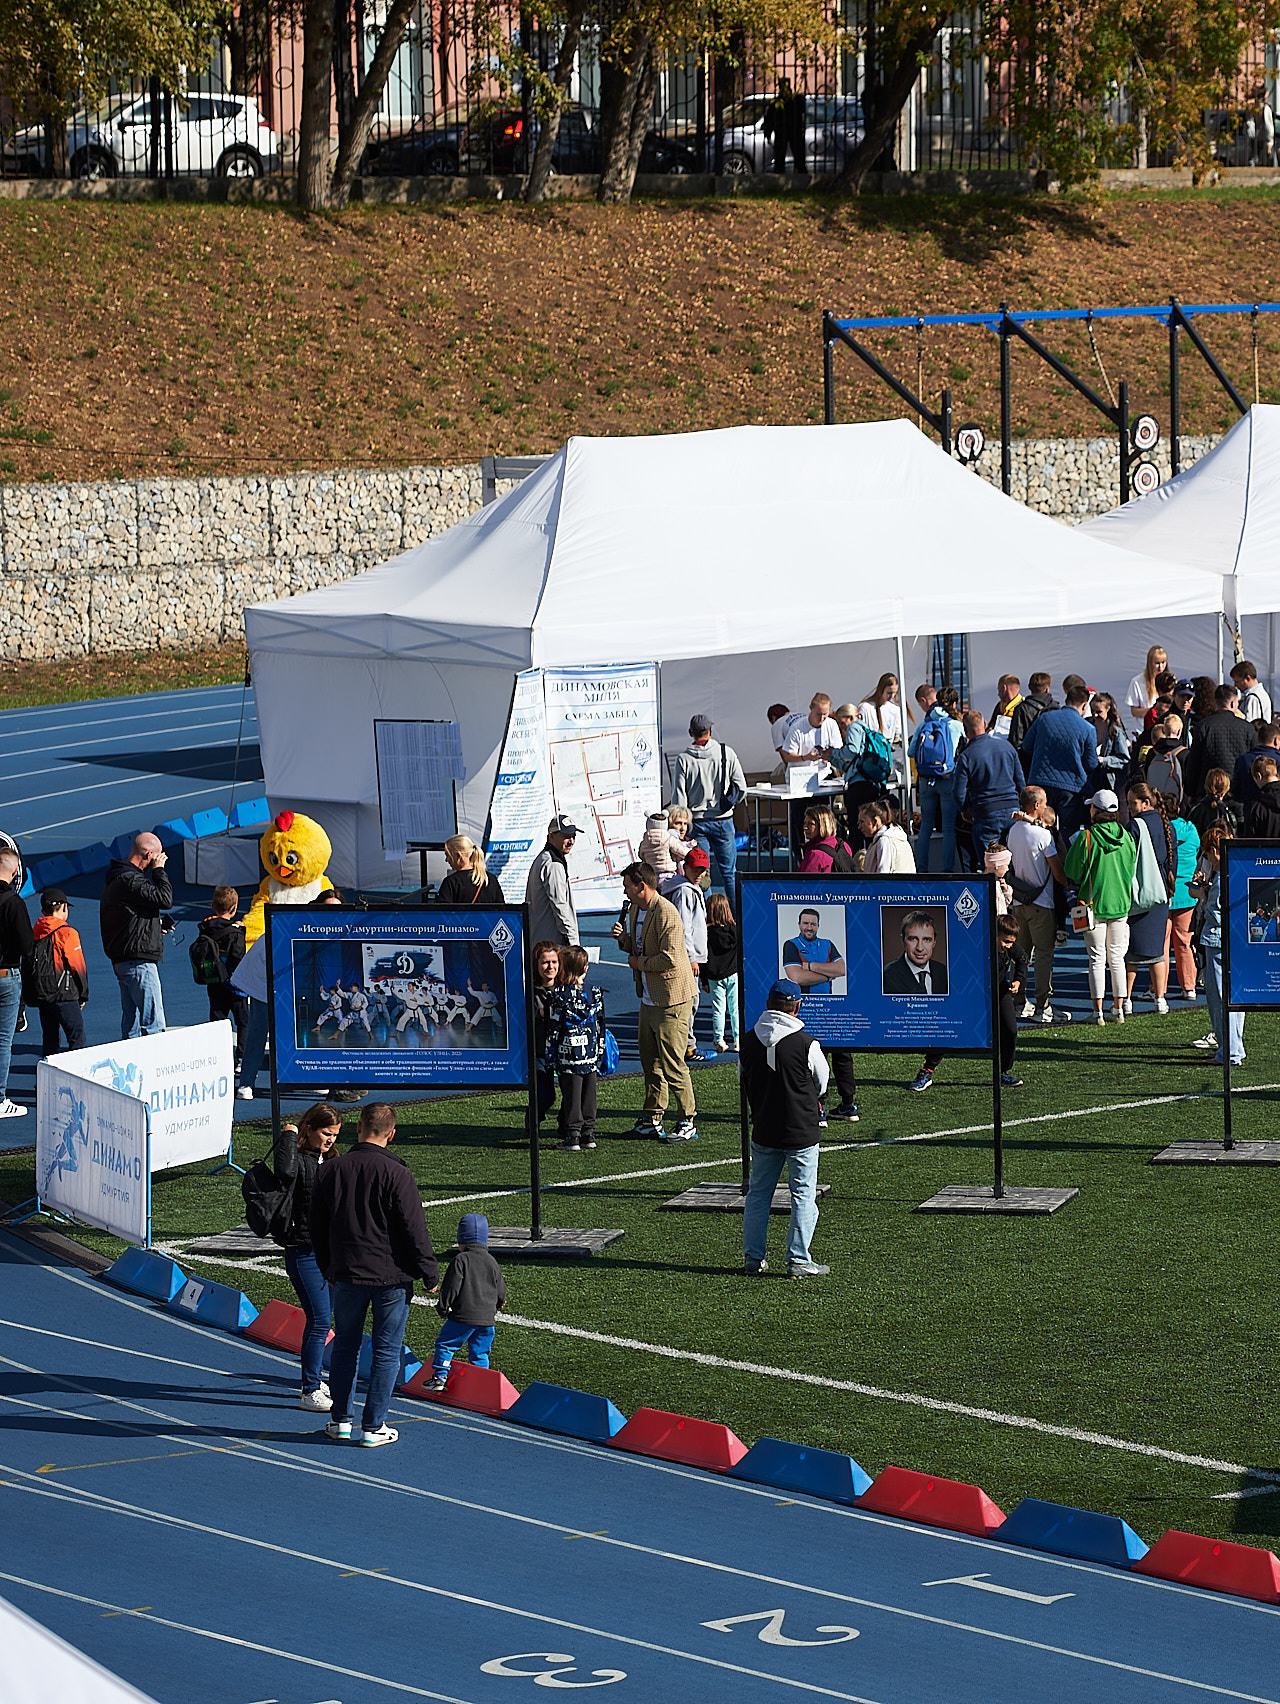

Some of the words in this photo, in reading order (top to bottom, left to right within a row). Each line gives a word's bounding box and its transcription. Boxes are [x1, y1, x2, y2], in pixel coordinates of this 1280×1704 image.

[551, 678, 649, 693] ДИНАМОВСКАЯ
[584, 691, 620, 703] МИЛЯ
[770, 893, 823, 902] Динамовцы
[825, 893, 871, 902] Удмуртии
[878, 893, 916, 902] гордость
[918, 893, 949, 902] страны
[298, 924, 343, 934] «История
[345, 924, 436, 934] Удмуртии-история
[437, 924, 480, 934] Динамо»
[156, 1056, 218, 1078] DYNAMO-UDM.RU
[150, 1076, 228, 1113] ДИНАМО
[165, 1115, 210, 1136] УДМУРТИЯ
[92, 1140, 142, 1182] ДИНАМО
[100, 1184, 130, 1204] УДМУРТИЯ
[190, 1288, 196, 1300] 4
